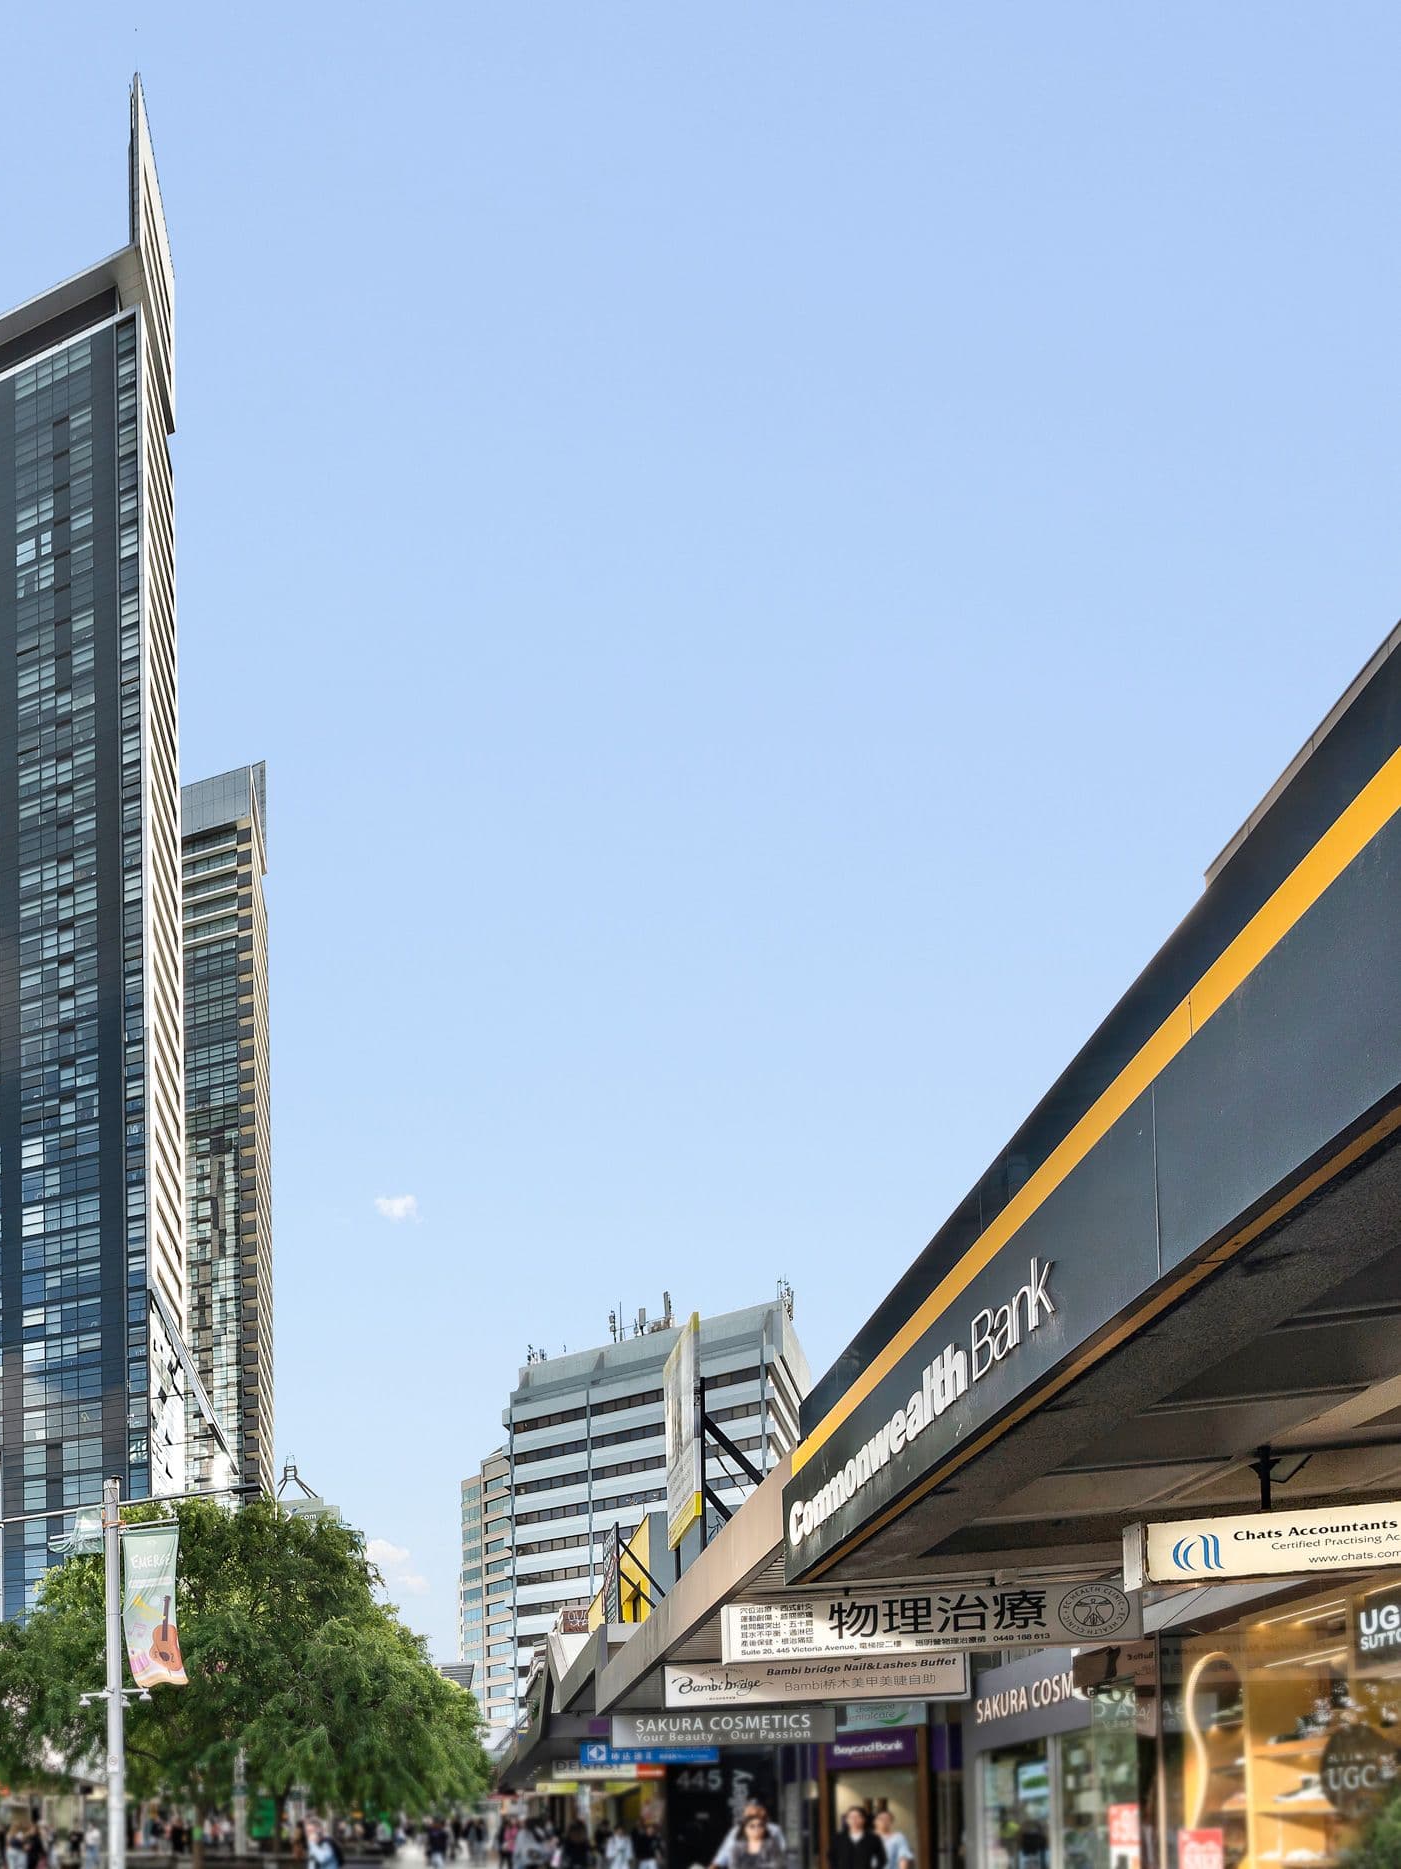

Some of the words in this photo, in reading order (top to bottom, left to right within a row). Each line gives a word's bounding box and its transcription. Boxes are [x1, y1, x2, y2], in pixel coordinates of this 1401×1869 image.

[789, 1342, 969, 1546] Commonwealth
[971, 1256, 1057, 1383] Bank
[1234, 1528, 1283, 1542] Chats
[1288, 1519, 1398, 1538] Accountants
[1271, 1537, 1321, 1551] Certified
[1325, 1535, 1382, 1546] Practising
[828, 1589, 1047, 1639] 物理治療
[741, 1648, 761, 1656] Suite
[776, 1646, 790, 1654] 445
[791, 1644, 823, 1653] Victoria
[824, 1643, 857, 1651] Avenue,
[766, 1666, 803, 1676] Bambi
[804, 1664, 842, 1676] bridge
[843, 1660, 918, 1673] Nail&Lashes
[920, 1657, 957, 1667] Buffet
[671, 1676, 724, 1694] Bambi
[724, 1672, 774, 1696] bridge
[976, 1686, 1028, 1724] SAKURA
[635, 1717, 704, 1732] SAKURA
[709, 1714, 811, 1730] COSMETICS
[636, 1733, 664, 1743] Your
[669, 1732, 713, 1743] Beauty
[730, 1730, 755, 1740] Our
[759, 1728, 811, 1739] Passion
[833, 1741, 874, 1756] Beyond
[875, 1739, 903, 1752] Bank
[677, 1769, 723, 1791] 445
